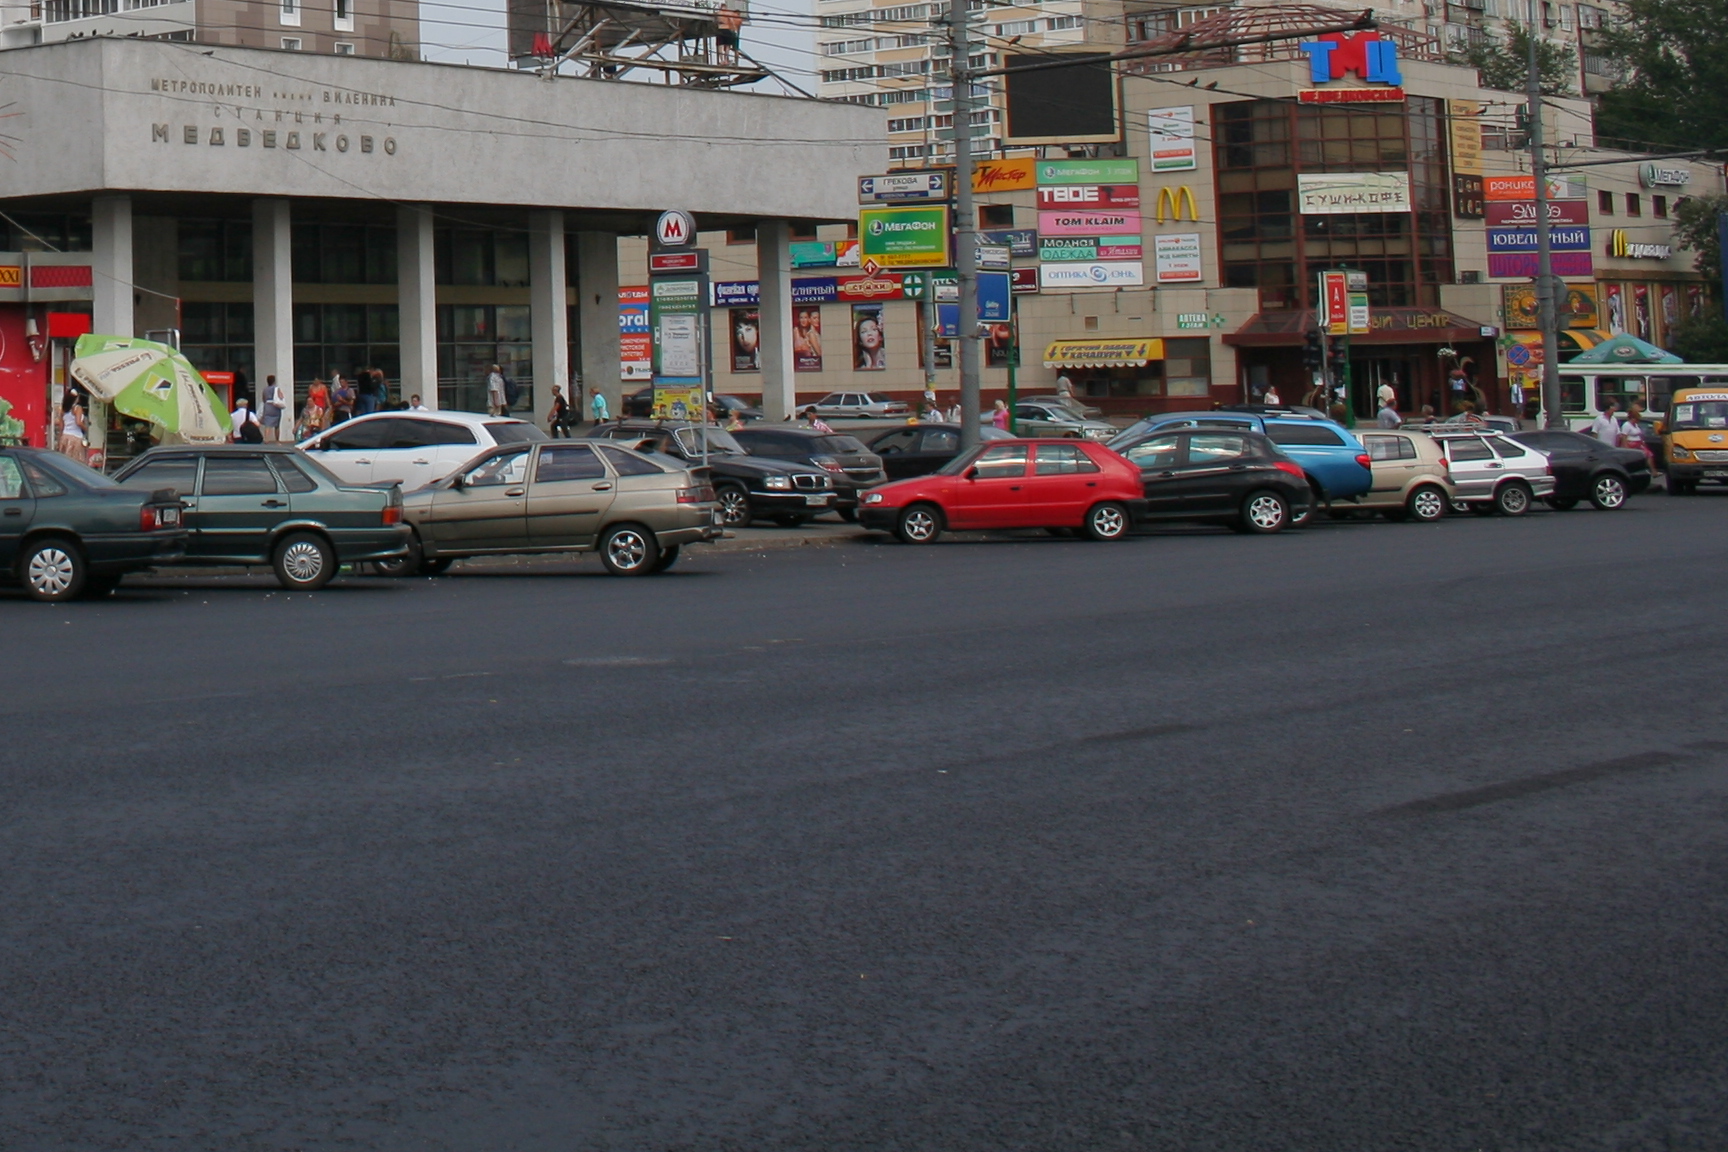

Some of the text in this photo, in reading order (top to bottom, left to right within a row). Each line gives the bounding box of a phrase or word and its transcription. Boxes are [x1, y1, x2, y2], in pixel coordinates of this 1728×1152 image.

[151, 78, 262, 98] МЕТРОПОЛИТЕН
[214, 106, 341, 125] СТАНЦИЯ
[151, 123, 397, 155] МЕДВЕДКОВО
[1038, 186, 1099, 202] ТВОЕ
[1055, 217, 1125, 226] TOM KLAIM
[1493, 230, 1585, 245] ЮВЕЛНЫЙ
[1042, 249, 1094, 259] ОДЕЖДА
[1179, 314, 1207, 322] АПТЕКА
